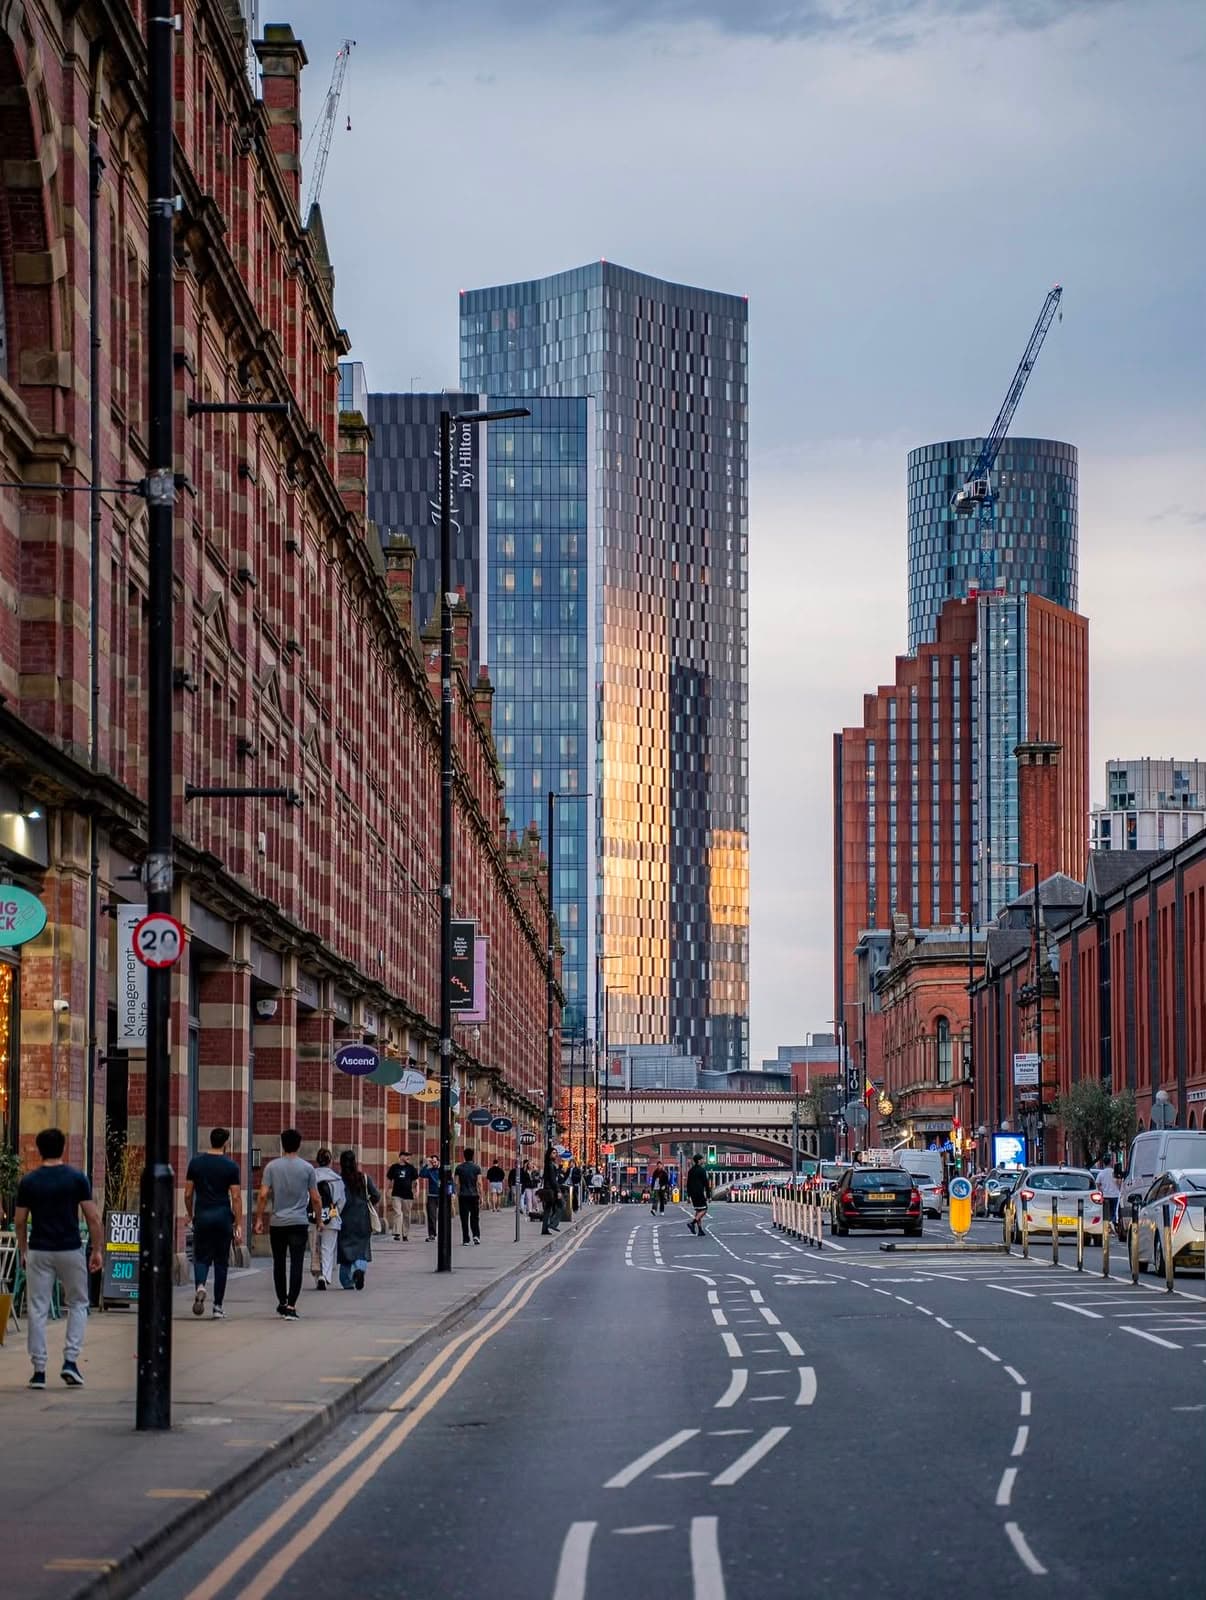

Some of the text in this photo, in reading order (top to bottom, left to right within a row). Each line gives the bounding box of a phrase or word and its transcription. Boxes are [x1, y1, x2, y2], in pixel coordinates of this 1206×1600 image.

[459, 424, 474, 488] by Hilton
[141, 929, 178, 950] 20
[123, 948, 139, 1037] Management
[341, 1056, 375, 1066] Ascend
[112, 1262, 133, 1279] £10
